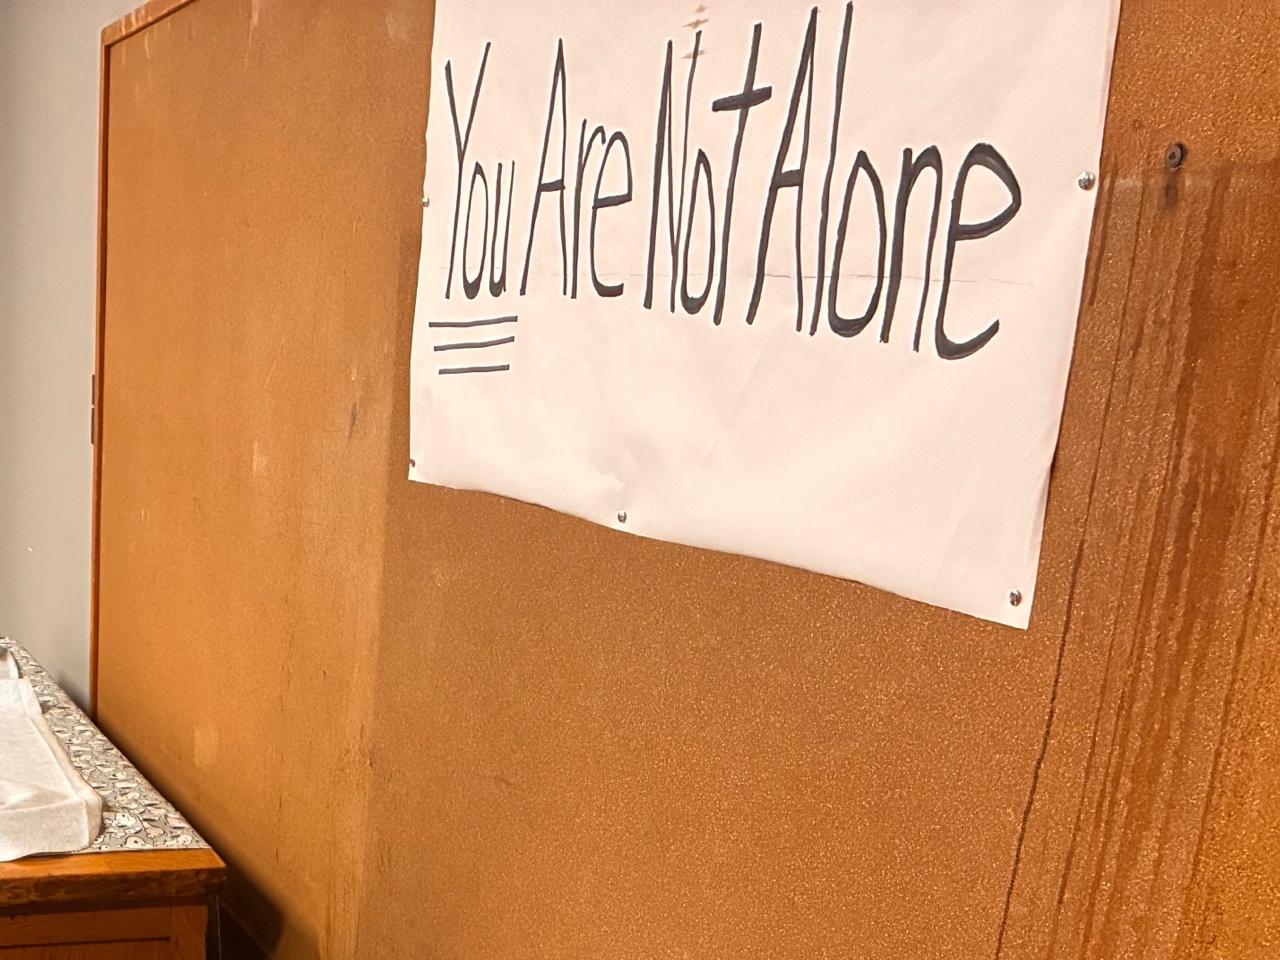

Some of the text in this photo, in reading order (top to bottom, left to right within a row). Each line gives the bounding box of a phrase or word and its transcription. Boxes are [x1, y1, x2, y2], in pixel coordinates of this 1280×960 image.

[444, 1, 1023, 361] You Are Not Alone
